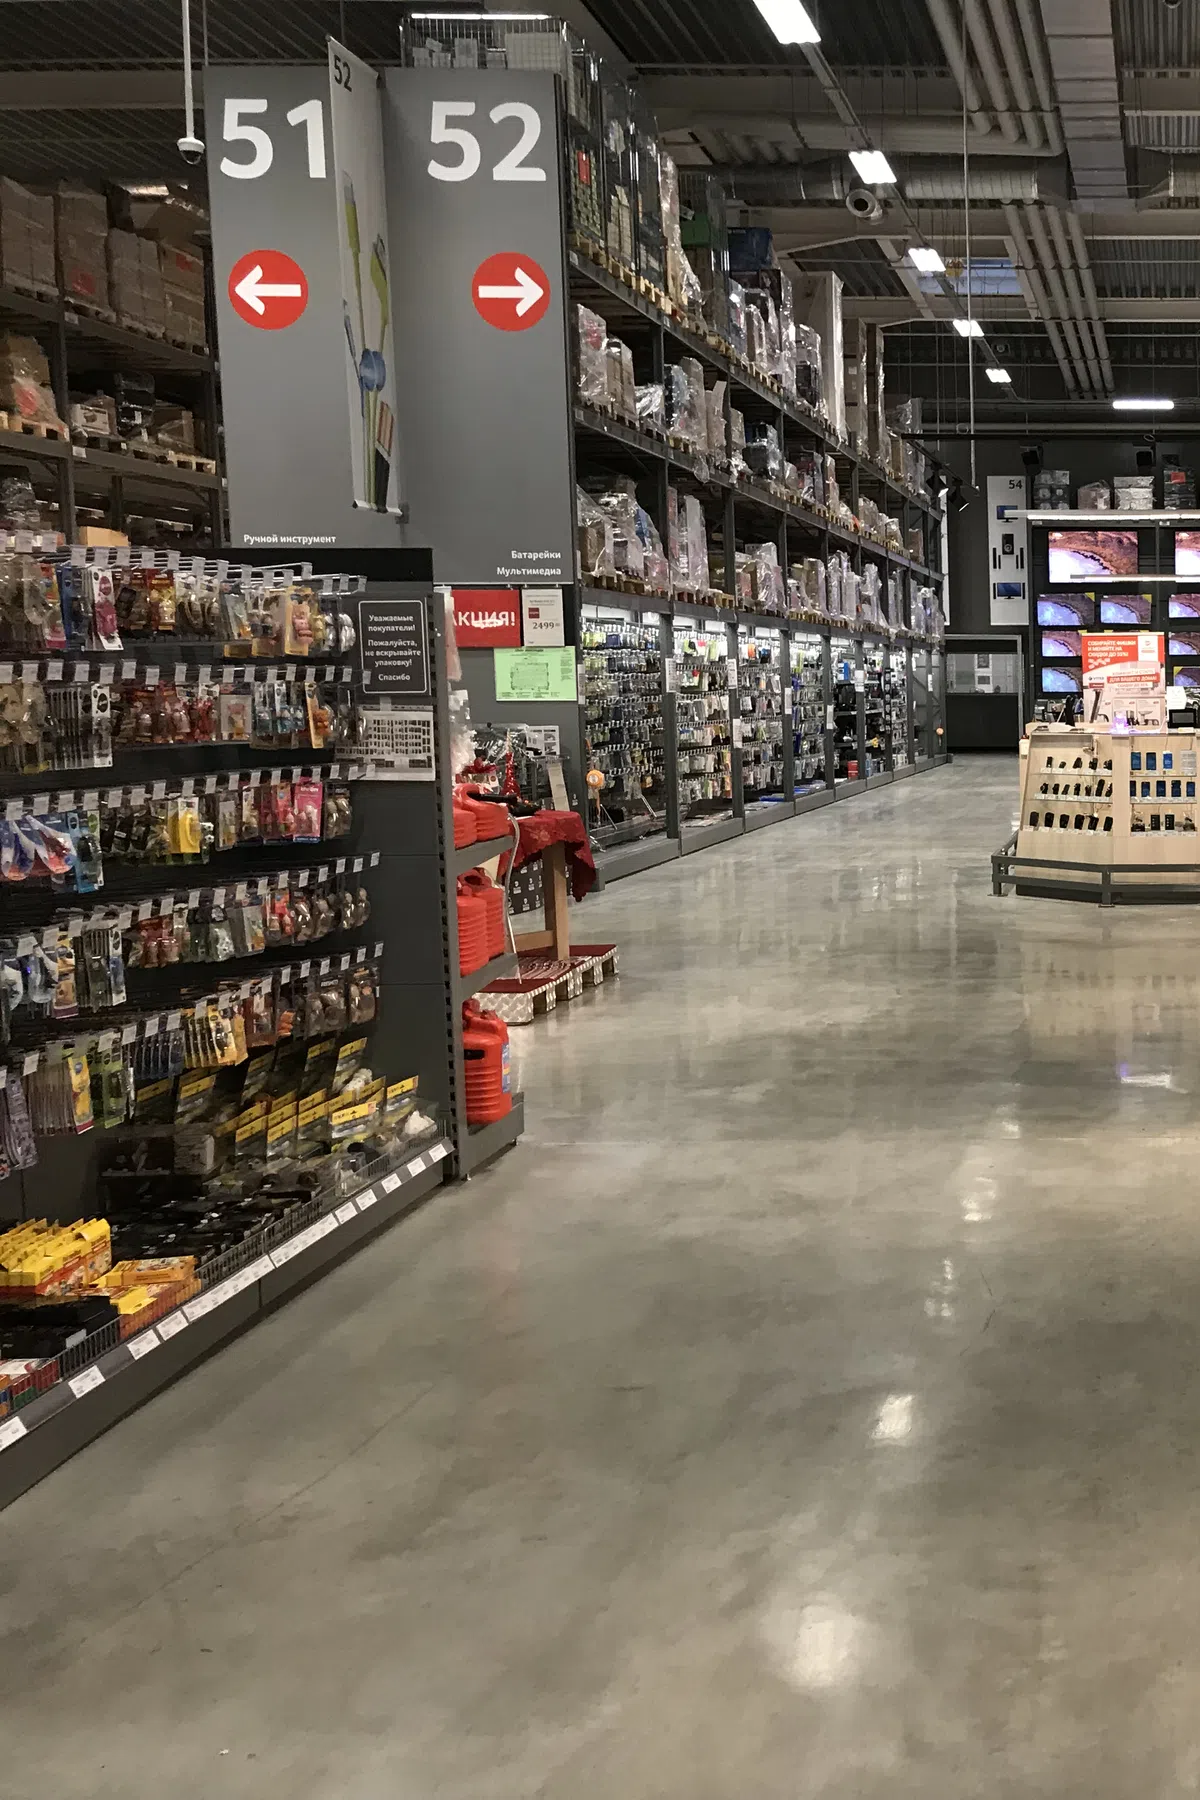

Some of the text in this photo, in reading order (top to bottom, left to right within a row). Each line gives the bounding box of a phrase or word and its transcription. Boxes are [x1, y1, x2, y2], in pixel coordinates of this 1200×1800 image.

[333, 54, 352, 92] 52
[219, 98, 327, 180] 51
[427, 100, 547, 182] 52
[1008, 479, 1023, 489] 54
[243, 533, 336, 545] Ручной инструмент
[511, 550, 562, 561] Батарейки
[496, 566, 562, 577] Мультимедиа
[368, 614, 414, 622] Уважаемые
[368, 624, 415, 633] покупатели!
[532, 621, 555, 630] 2499
[367, 638, 417, 648] Пожалуйста,
[376, 649, 421, 657] вскрывайте
[374, 659, 412, 667] упаковку!
[378, 673, 410, 681] Спасибо
